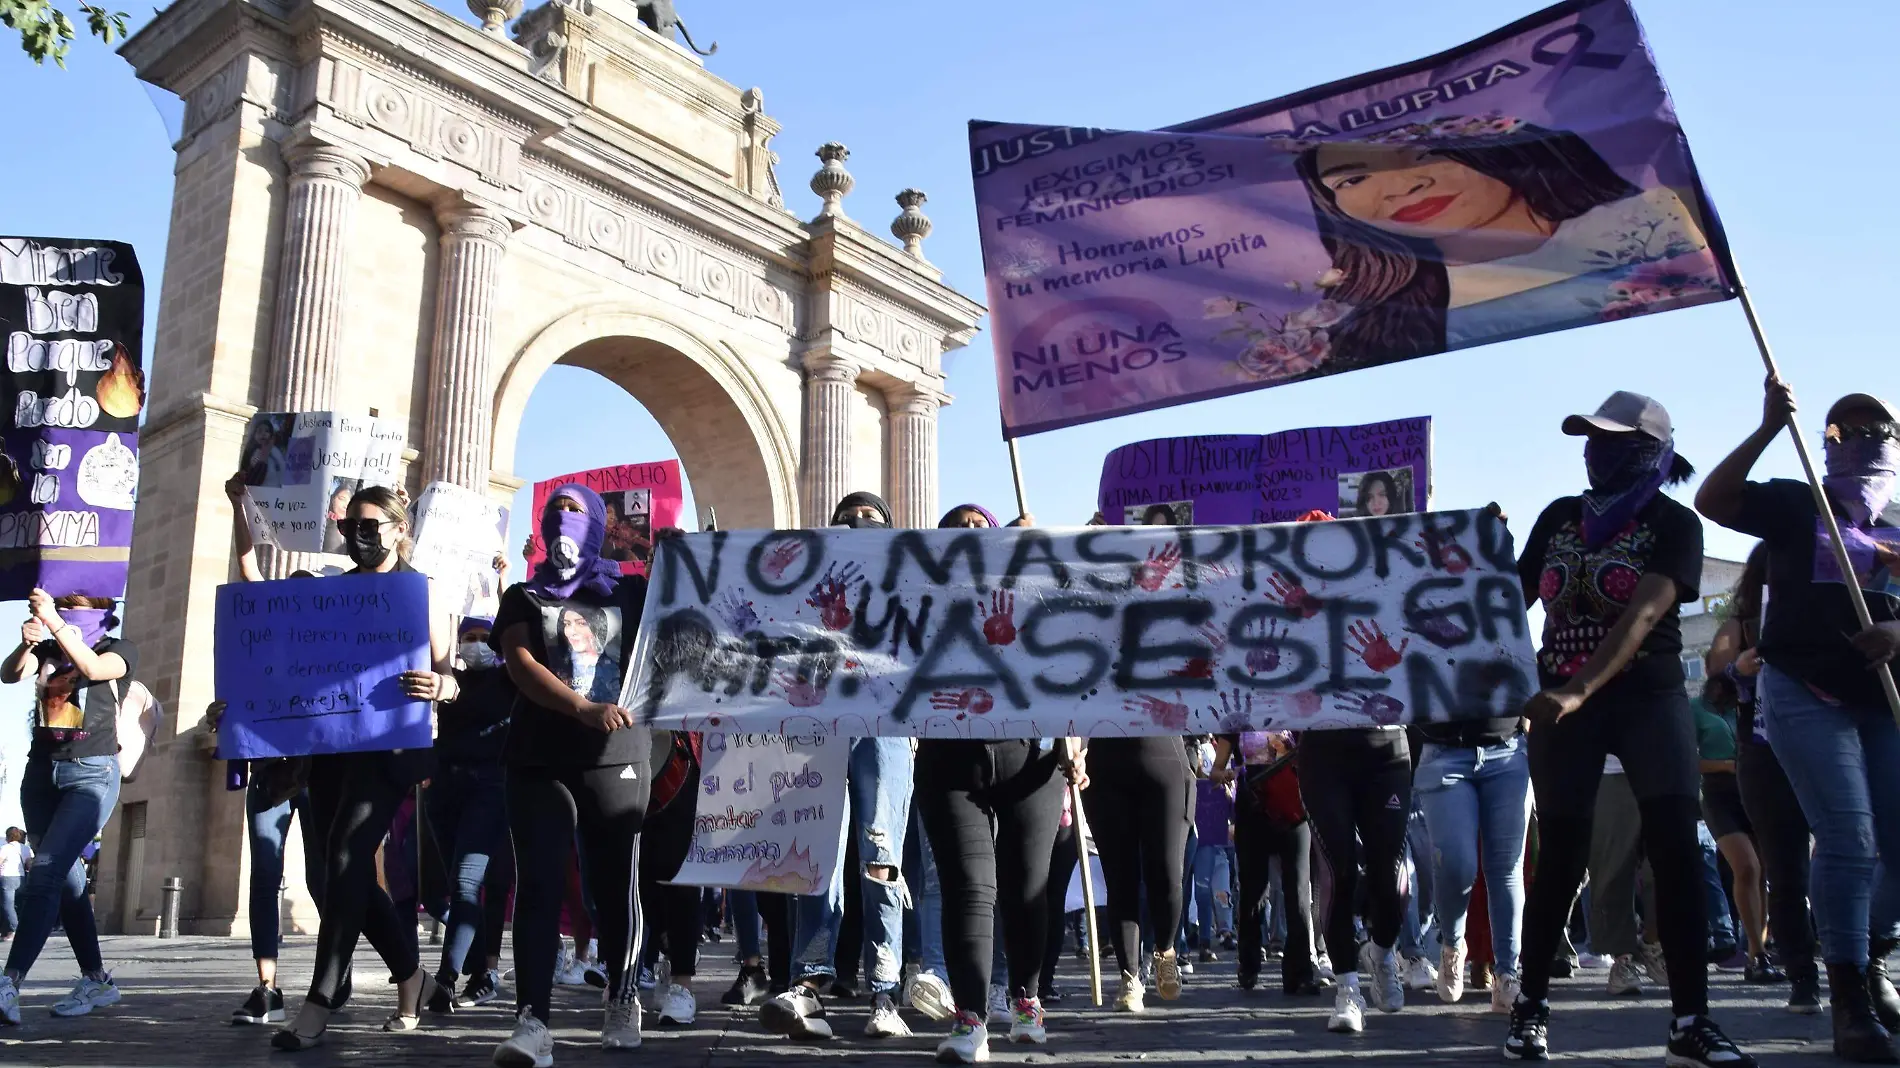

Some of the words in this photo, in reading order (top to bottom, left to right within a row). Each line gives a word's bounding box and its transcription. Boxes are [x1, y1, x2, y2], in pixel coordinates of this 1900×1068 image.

[1346, 63, 1521, 129] LUPITA
[976, 127, 1118, 175] JUSTI
[996, 163, 1235, 231] FEMINICIDIOS!
[1020, 177, 1098, 210] ALTO
[1141, 150, 1206, 180] LOS
[0, 241, 123, 283] Mirame
[1057, 224, 1205, 265] Honramos
[1005, 280, 1033, 299] tu
[1043, 256, 1169, 291] memoria
[1178, 231, 1268, 269] Lupita
[27, 288, 96, 331] Bien
[10, 336, 112, 385] Porque
[1012, 343, 1060, 370] NI
[1076, 320, 1181, 356] UNA
[1012, 342, 1188, 395] MENOS
[17, 389, 94, 426] Puedo
[299, 414, 332, 430] Justicia
[1258, 427, 1351, 461] LUPITA
[33, 473, 57, 503] la
[586, 465, 668, 491] MARCHO
[1103, 488, 1153, 507] ICTIMA
[1159, 484, 1177, 501] DE
[275, 498, 284, 510] la
[288, 502, 307, 511] voz
[0, 512, 97, 547] PROXIMA
[271, 520, 286, 534] que
[660, 528, 826, 606] NO
[882, 527, 1140, 595] MAS
[231, 592, 256, 618] Por
[267, 595, 301, 613] mis
[313, 591, 392, 616] amigas
[852, 581, 934, 659] UN
[1403, 576, 1524, 648] GA
[289, 627, 347, 644] tienen
[357, 627, 414, 646] miedo
[264, 665, 274, 676] a
[287, 660, 371, 678] denunciar
[706, 731, 727, 751] a
[770, 763, 823, 803] pudo
[693, 805, 763, 836] matar
[771, 809, 786, 826] a
[794, 804, 825, 824] mi
[686, 838, 781, 865] hermana
